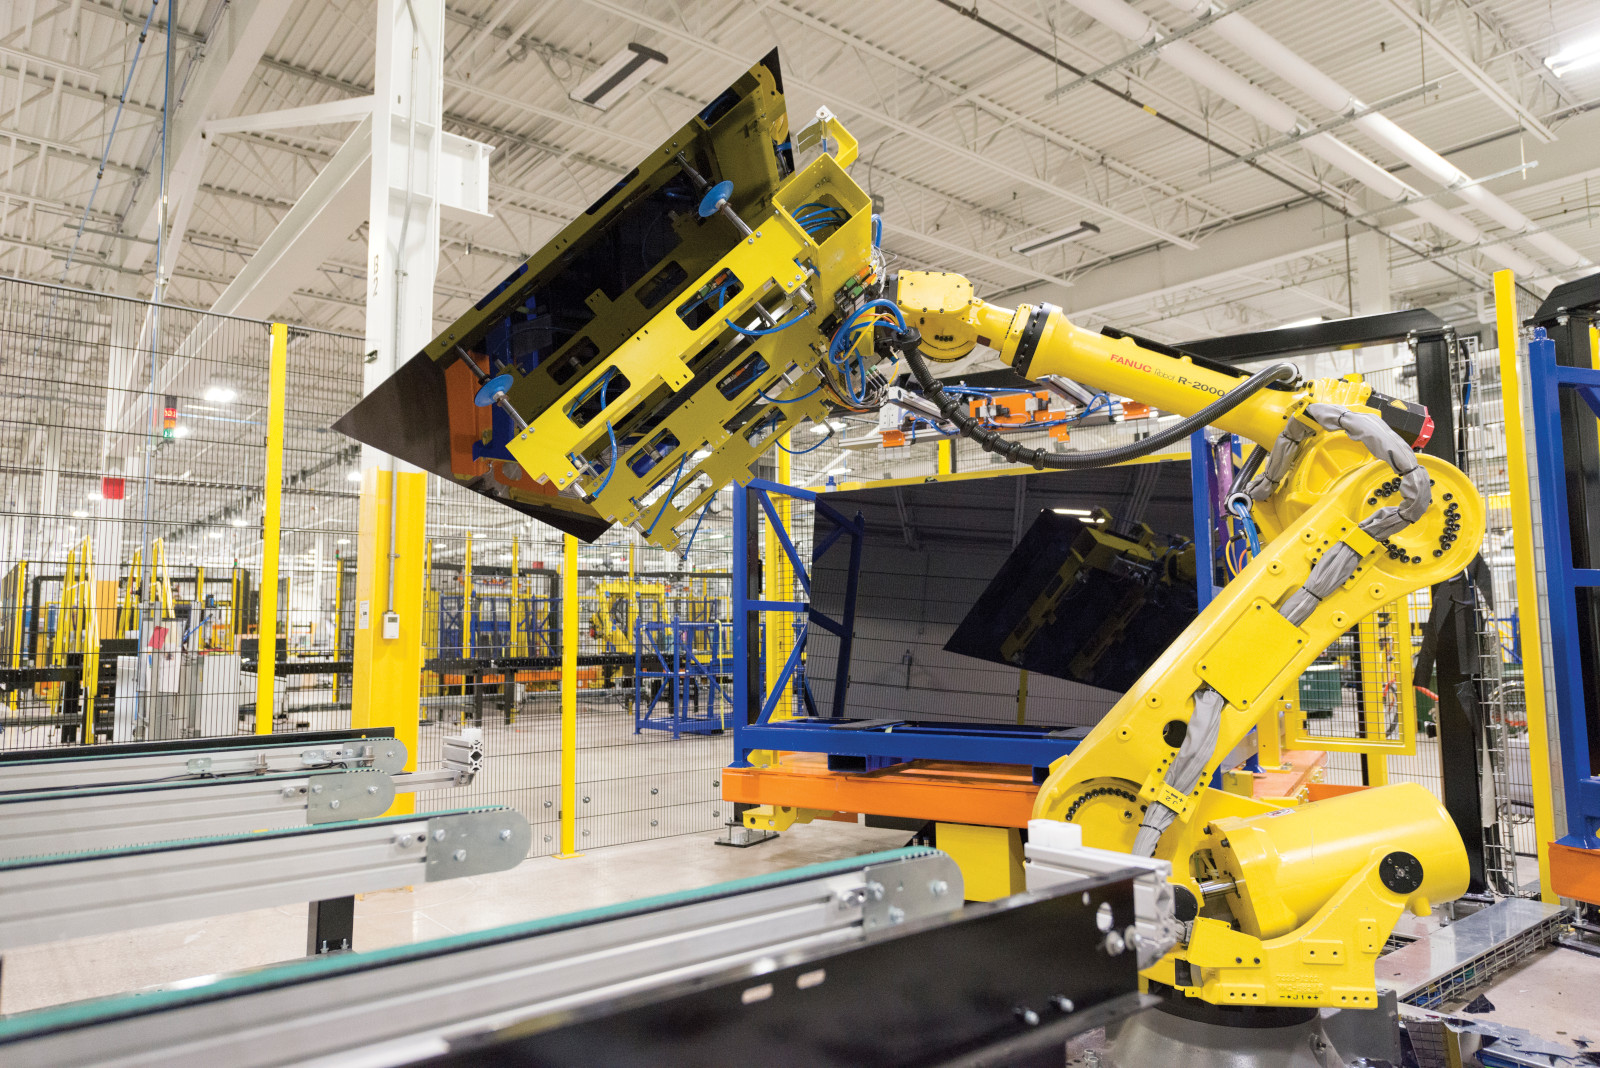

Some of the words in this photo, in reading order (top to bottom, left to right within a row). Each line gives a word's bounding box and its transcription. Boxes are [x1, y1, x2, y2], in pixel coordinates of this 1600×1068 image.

[1110, 354, 1152, 373] FANUC
[1155, 368, 1175, 381] Robot
[1177, 376, 1232, 397] R-2000
